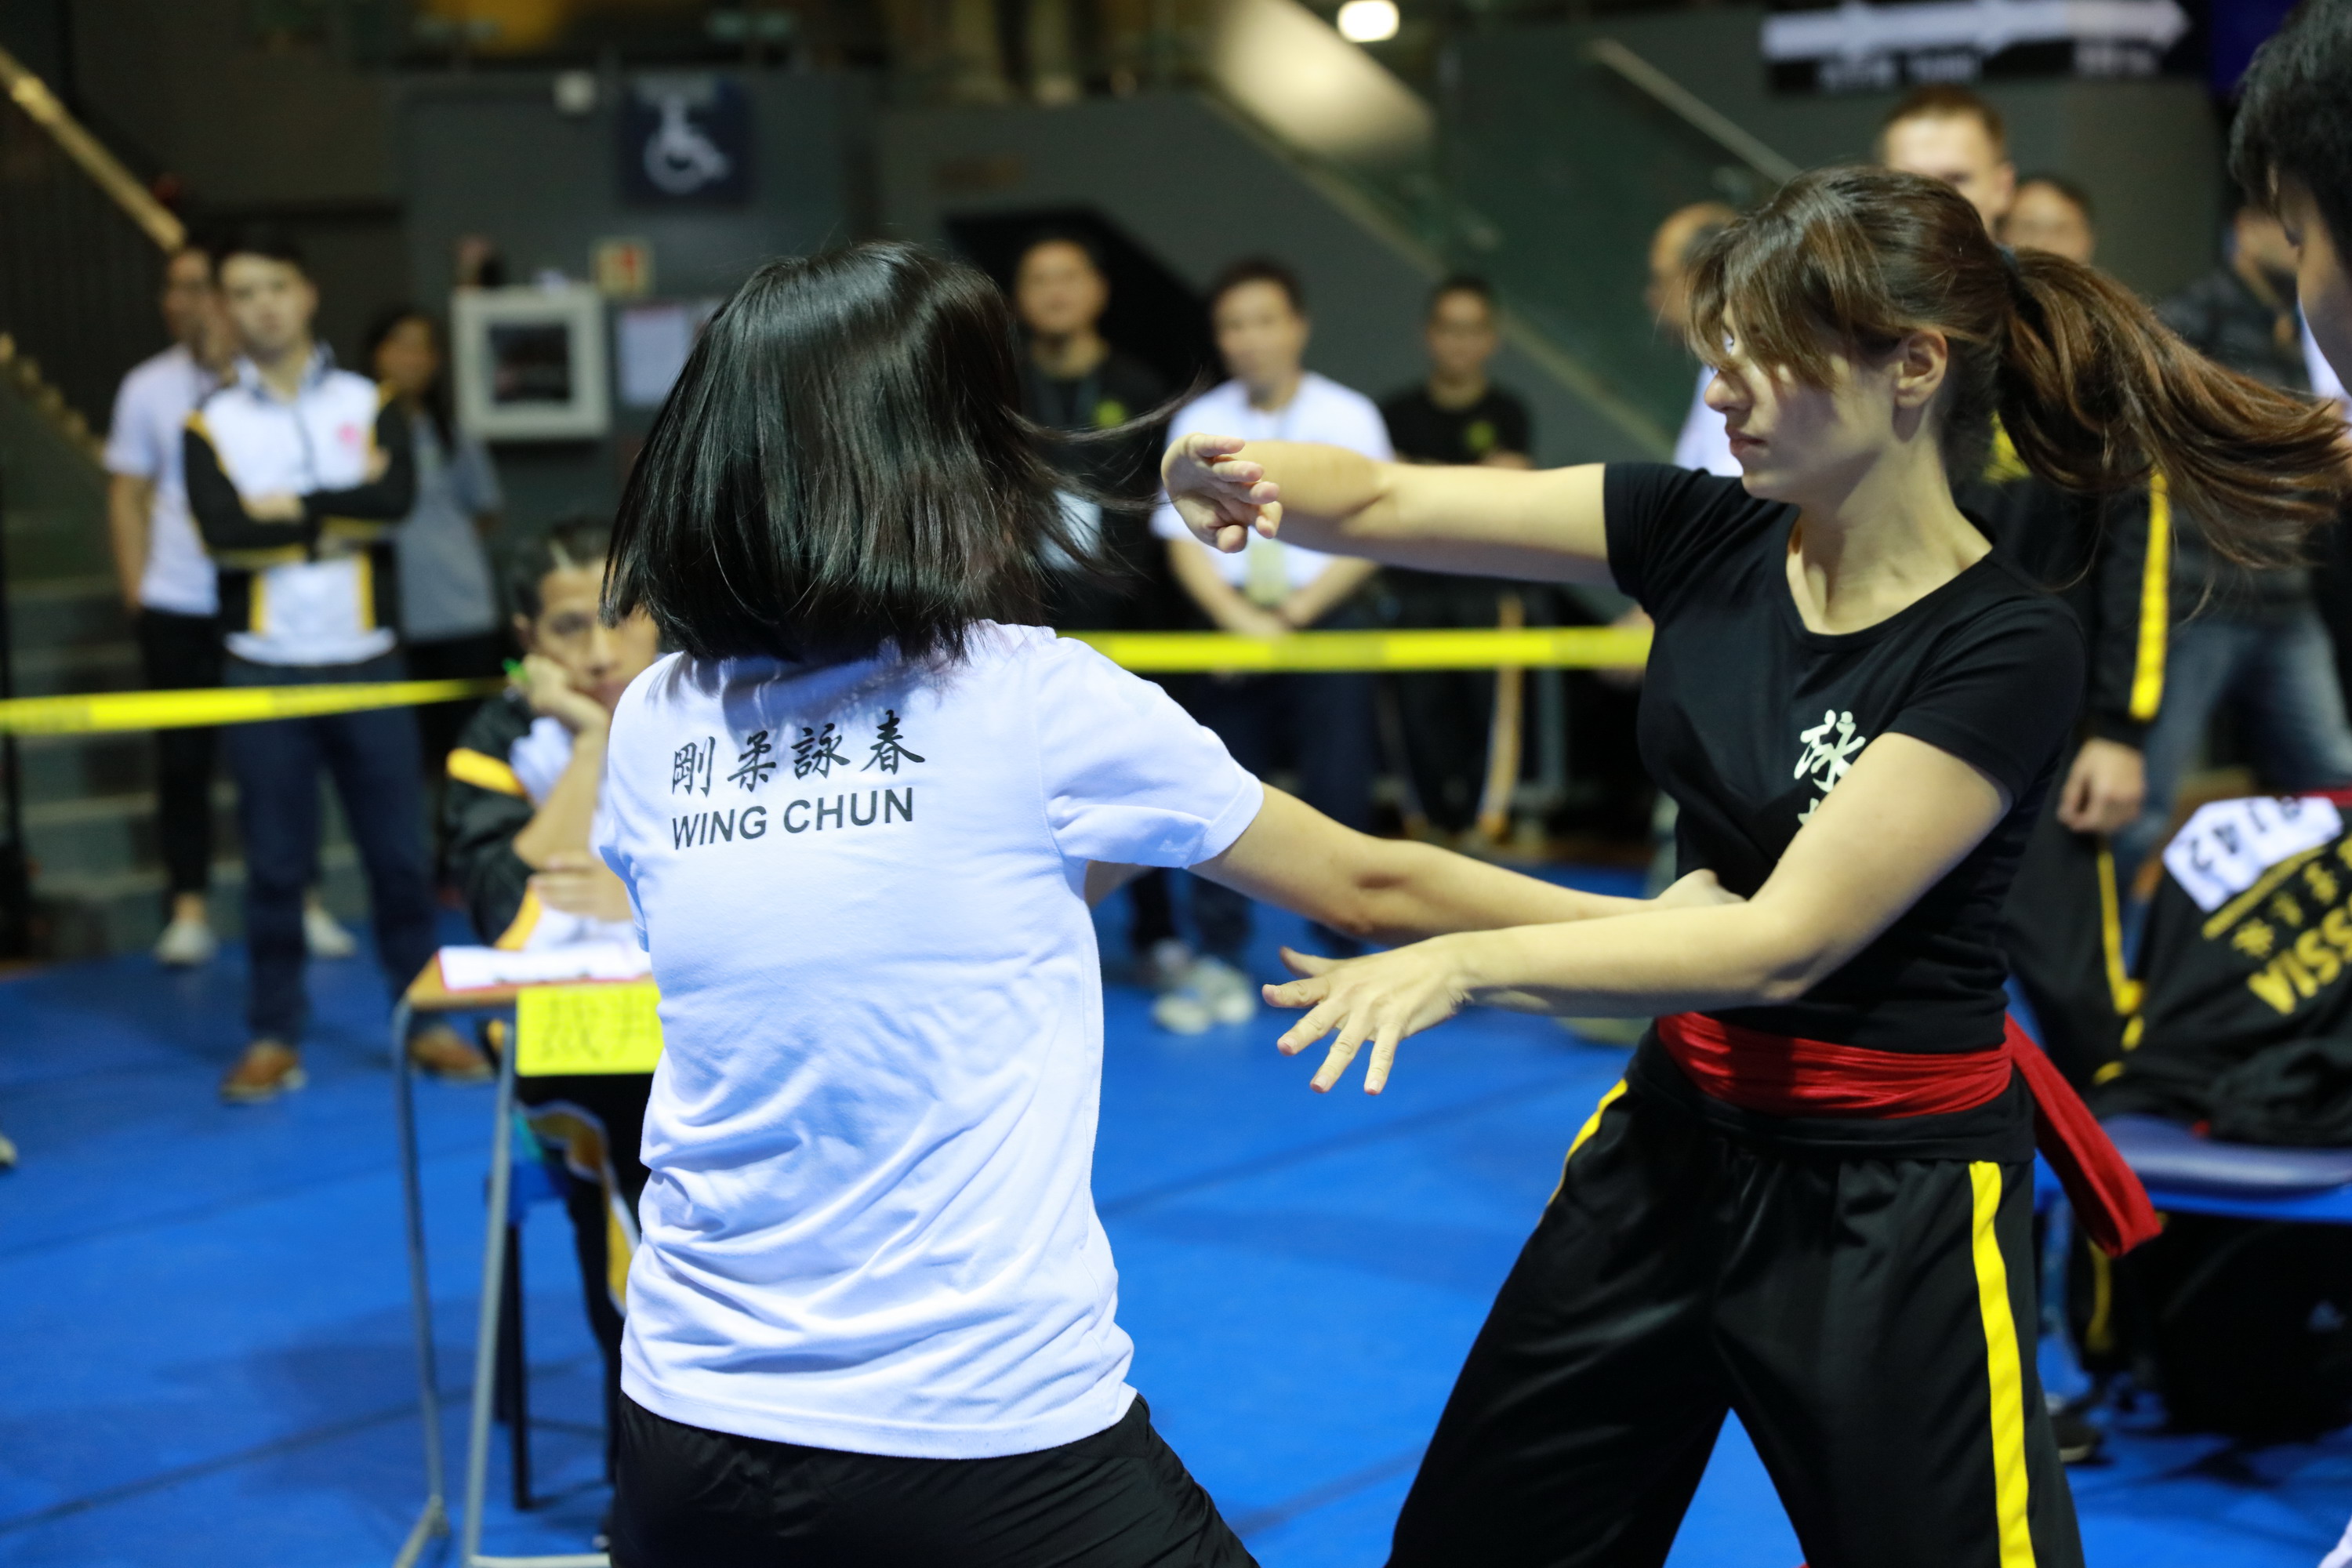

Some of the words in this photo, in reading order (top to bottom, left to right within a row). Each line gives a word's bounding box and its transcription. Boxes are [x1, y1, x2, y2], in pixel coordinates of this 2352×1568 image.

[672, 710, 925, 797] 剛柔詠春
[672, 805, 768, 850] WING
[783, 787, 913, 833] CHUN
